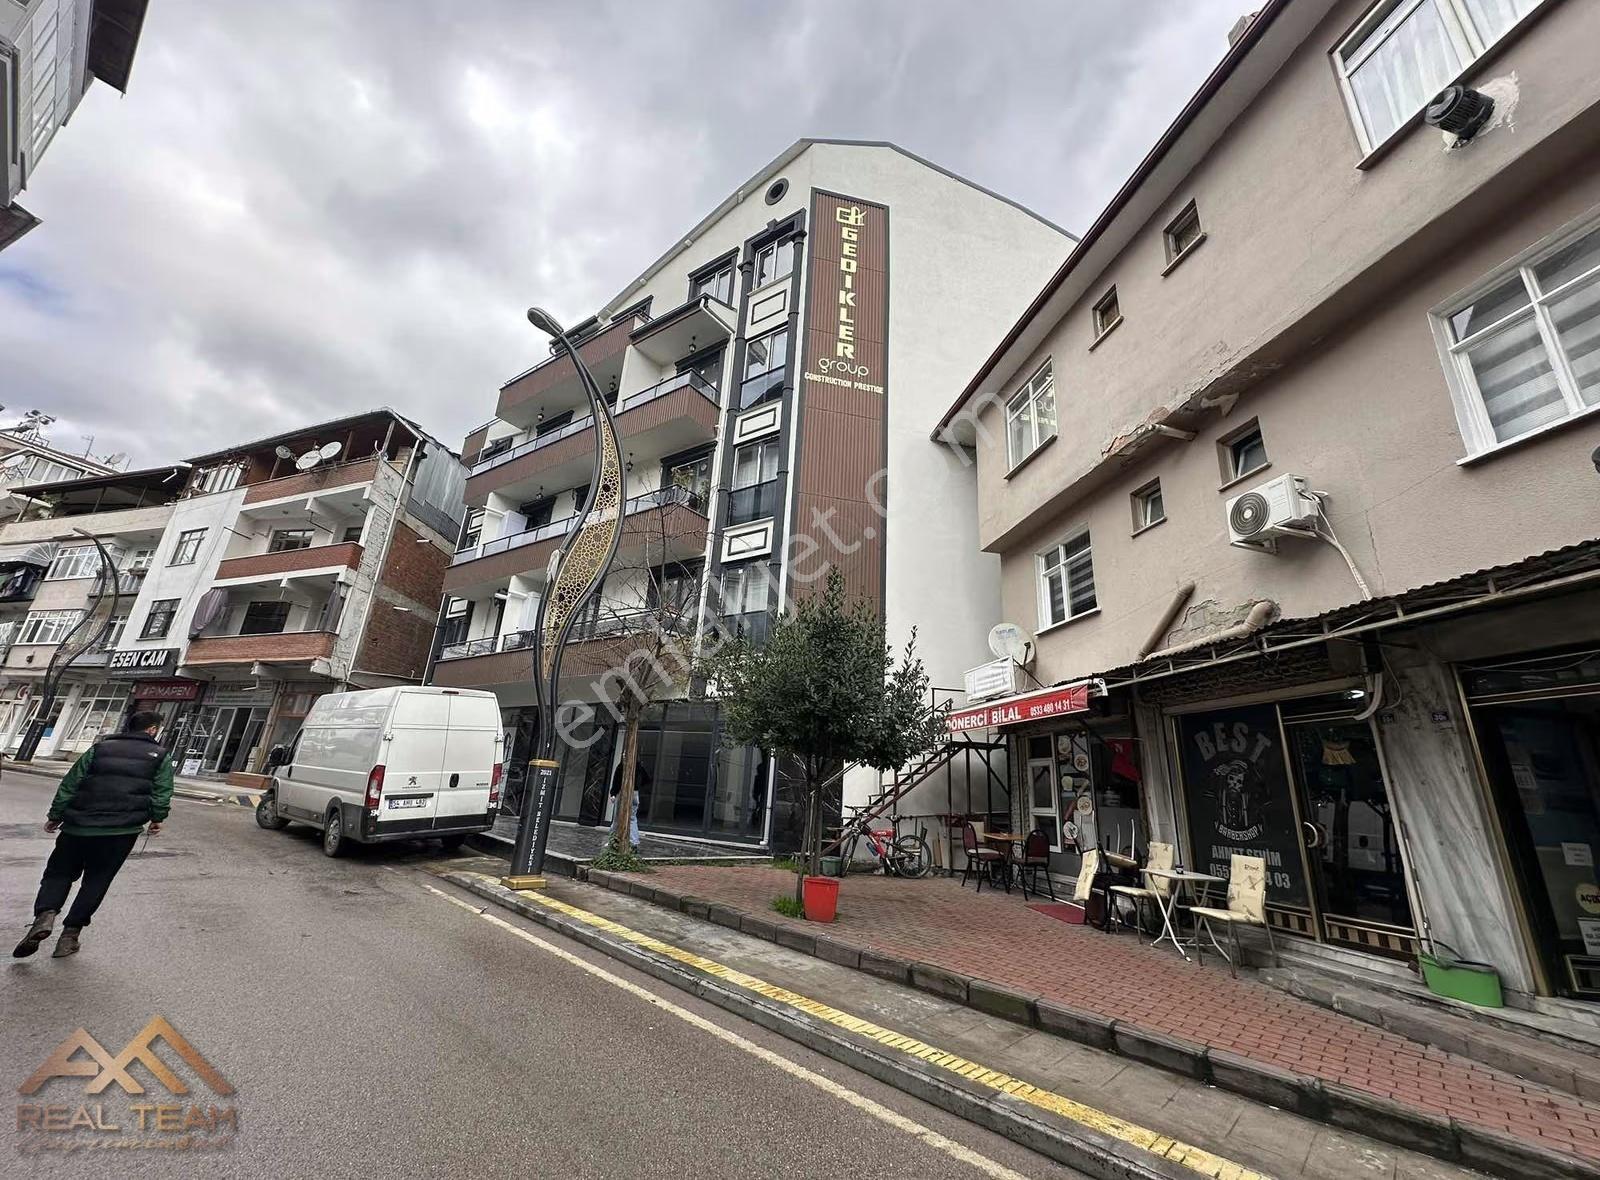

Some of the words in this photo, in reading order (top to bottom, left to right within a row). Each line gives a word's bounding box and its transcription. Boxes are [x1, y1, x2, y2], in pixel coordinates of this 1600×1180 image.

[818, 358, 869, 378] group
[804, 371, 852, 389] CONSTRUCTION
[109, 652, 141, 668] ESEN
[140, 650, 169, 666] CAM
[992, 707, 1022, 724] BİLAL
[1195, 722, 1273, 762] BEST
